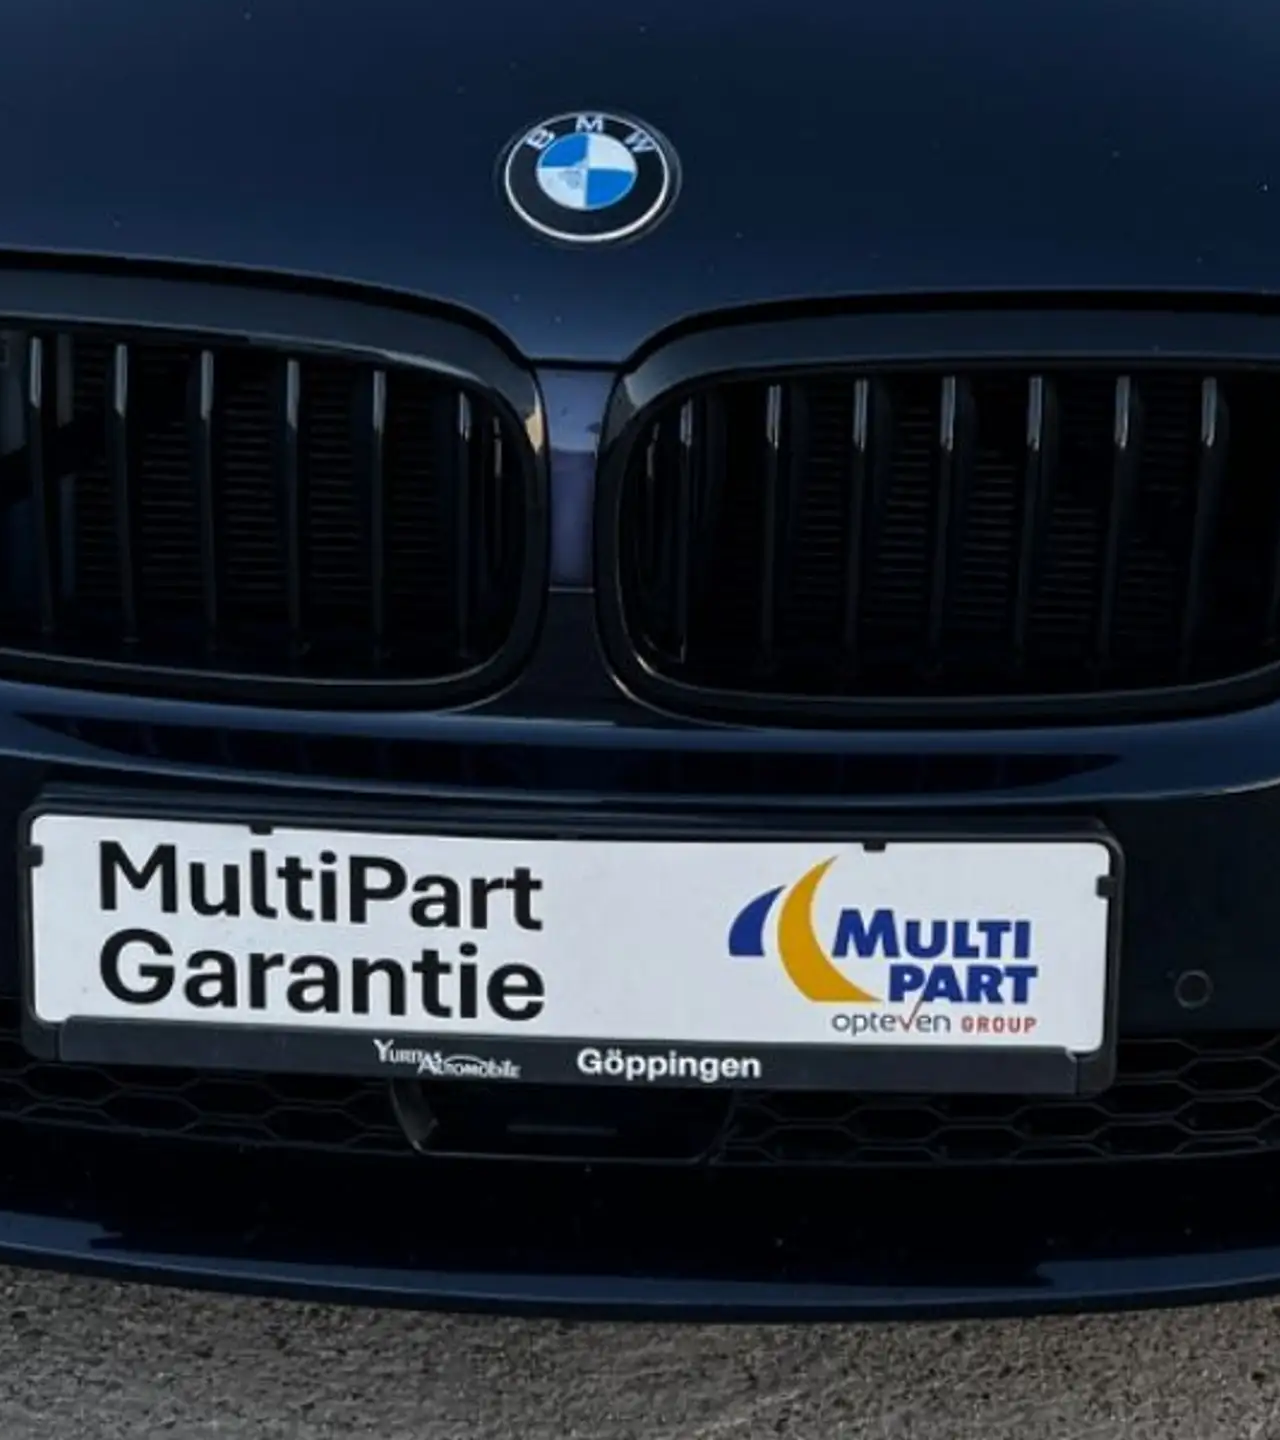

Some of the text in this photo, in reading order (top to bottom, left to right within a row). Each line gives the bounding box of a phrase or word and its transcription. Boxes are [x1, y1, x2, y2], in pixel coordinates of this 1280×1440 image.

[525, 114, 657, 153] BMW
[99, 840, 543, 931] MultiPart
[831, 908, 1032, 959] MULTI
[100, 928, 545, 1021] Garantie
[888, 964, 1038, 1004] PART
[831, 1008, 1036, 1036] opteven GROUP
[577, 1047, 762, 1083] Göppingen
